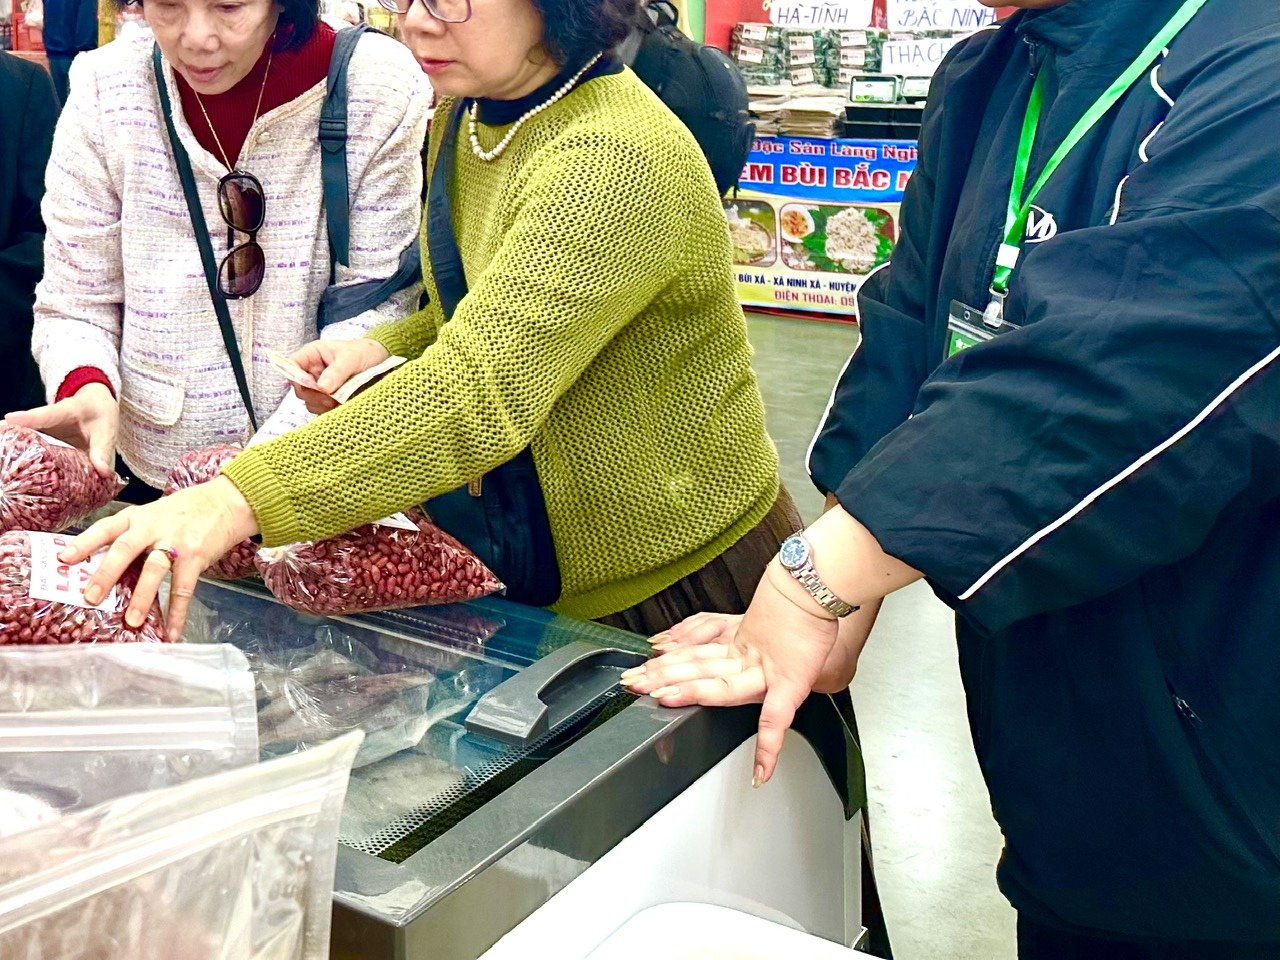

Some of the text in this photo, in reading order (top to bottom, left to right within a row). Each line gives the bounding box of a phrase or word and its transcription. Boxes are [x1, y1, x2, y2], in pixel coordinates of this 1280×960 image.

[789, 141, 825, 155] Sản
[831, 143, 877, 159] Làng
[781, 162, 825, 187] BÙI
[835, 163, 888, 189] BẮC
[787, 278, 808, 288] NINH
